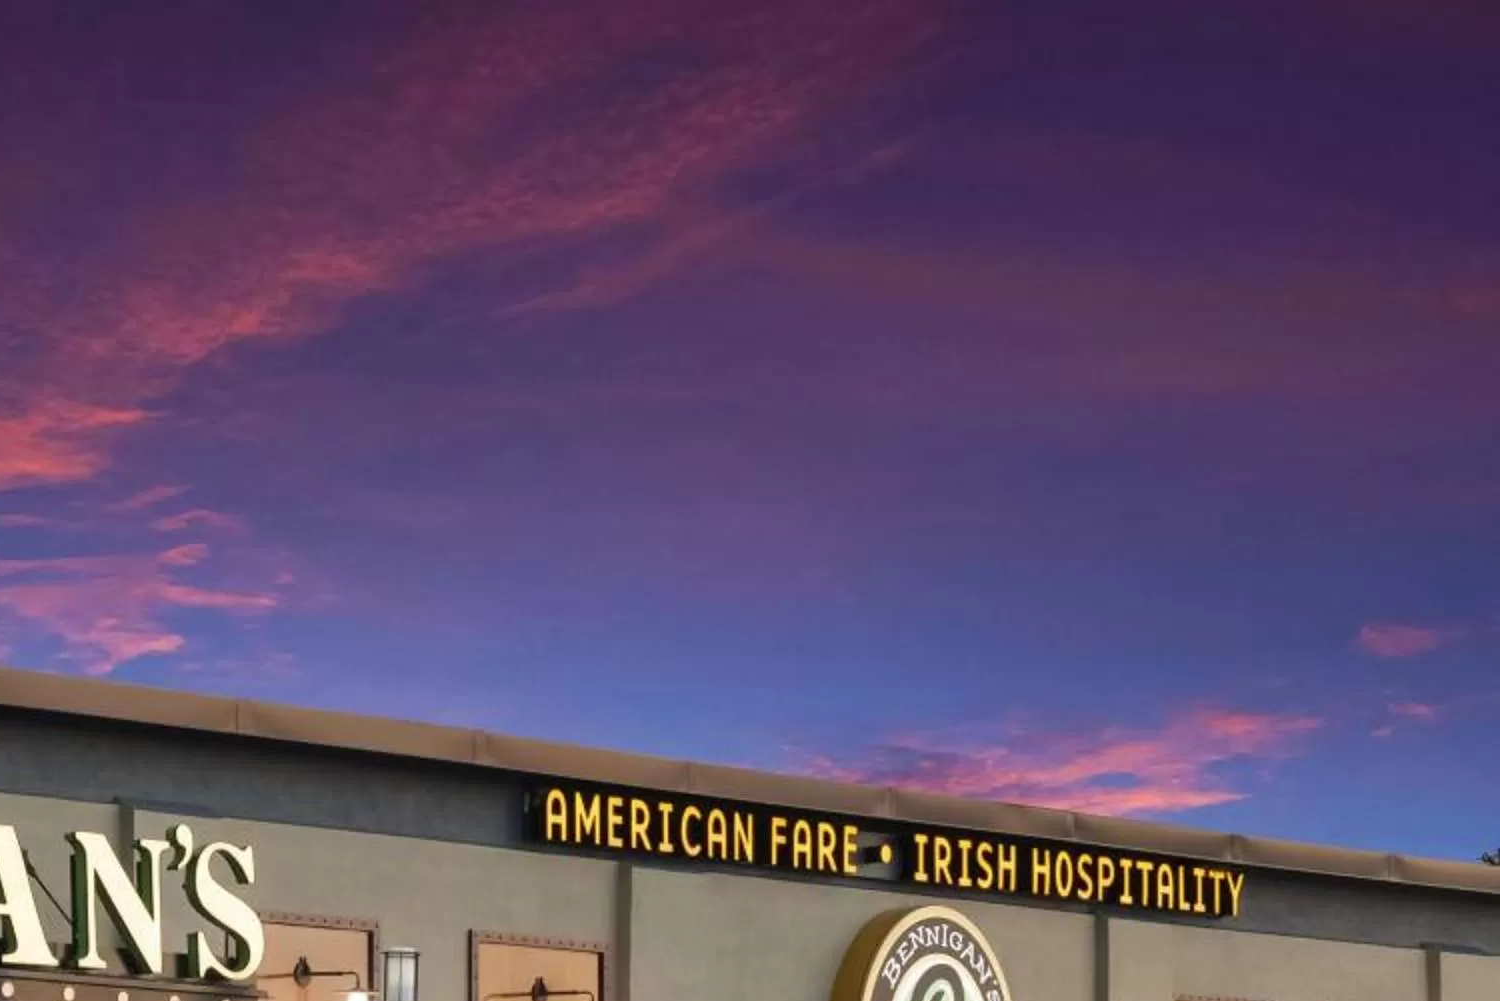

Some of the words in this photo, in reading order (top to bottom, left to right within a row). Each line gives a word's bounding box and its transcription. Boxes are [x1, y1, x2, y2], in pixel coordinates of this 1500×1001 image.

[545, 788, 754, 864] AMERICAN
[770, 817, 859, 875] FARE
[913, 832, 1017, 893] IRISH
[1031, 845, 1245, 917] HOSPITALITY
